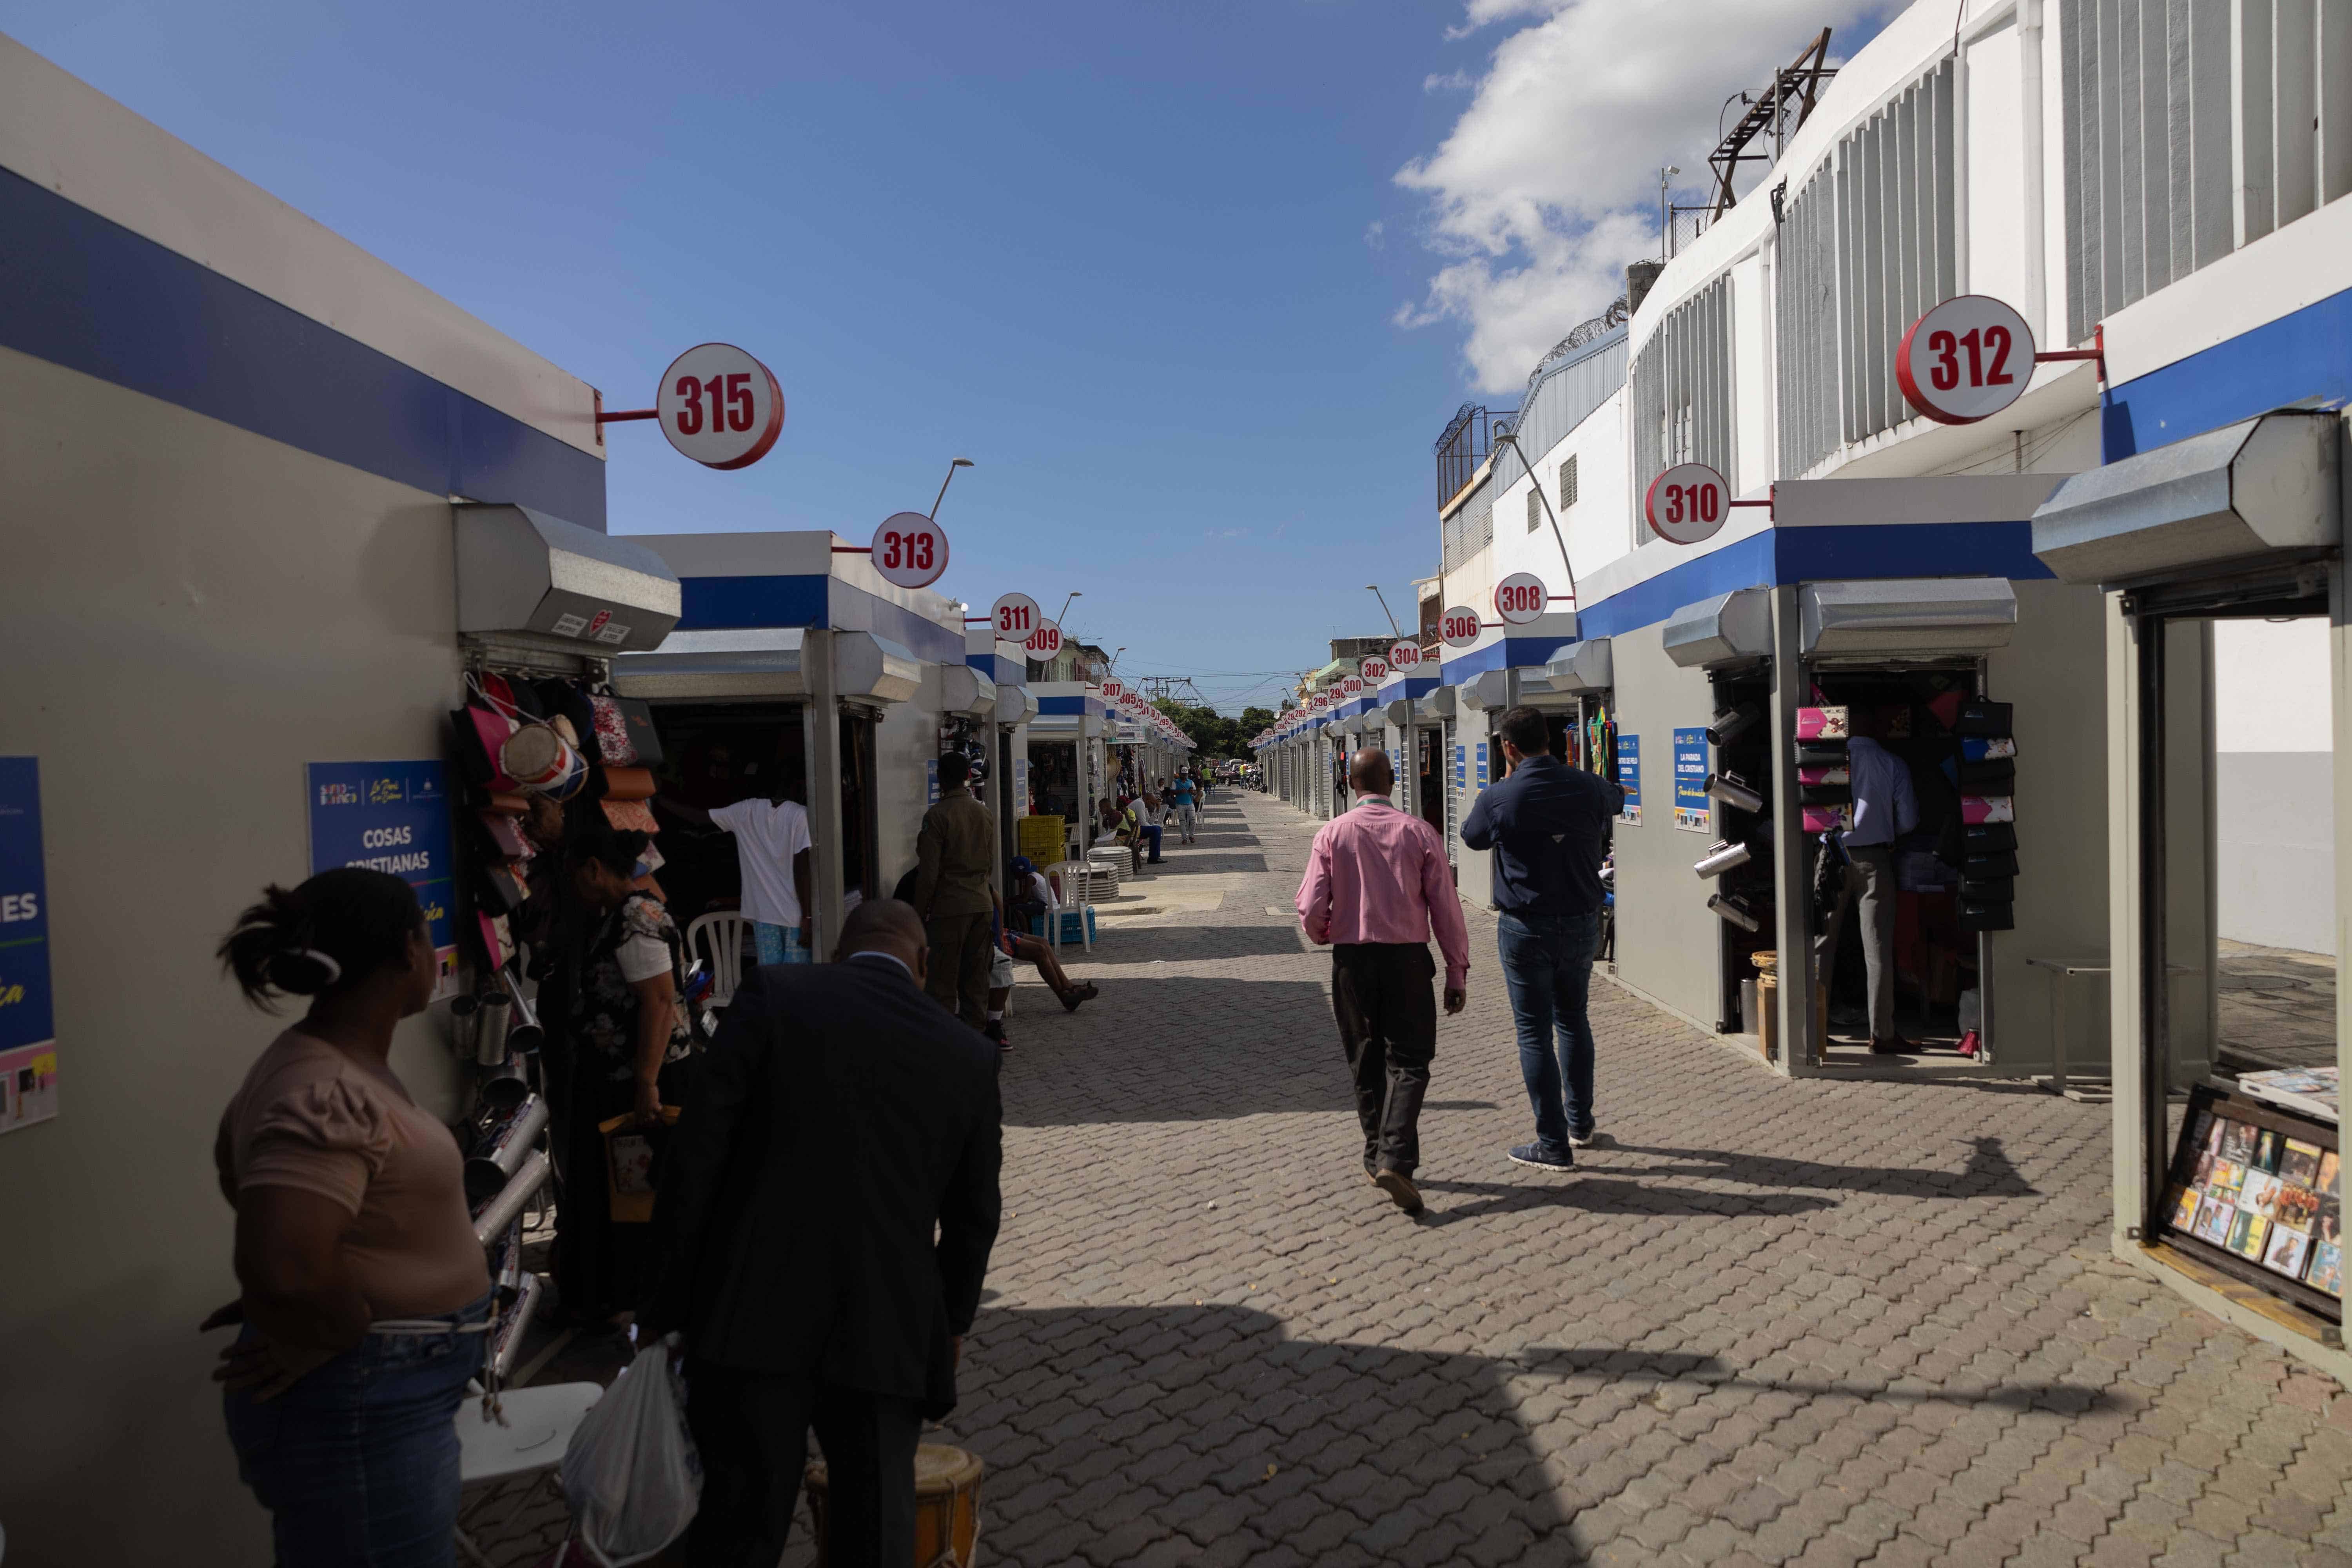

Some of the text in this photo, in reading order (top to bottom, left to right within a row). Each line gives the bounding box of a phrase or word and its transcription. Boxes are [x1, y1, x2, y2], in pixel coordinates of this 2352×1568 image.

[1928, 325, 2013, 391] 312
[675, 373, 755, 435] 315
[1666, 483, 1718, 524] 310
[883, 531, 934, 570] 313
[1502, 586, 1541, 612] 308
[1000, 606, 1030, 631] 311
[1445, 616, 1477, 638] 306
[1026, 629, 1059, 650] 309
[1395, 648, 1419, 664] 304
[1365, 663, 1386, 677] 302
[1103, 683, 1121, 697] 307
[1344, 680, 1361, 692] 300
[1120, 693, 1136, 704] 305
[1314, 697, 1328, 706] 296
[363, 825, 412, 849] COSAS
